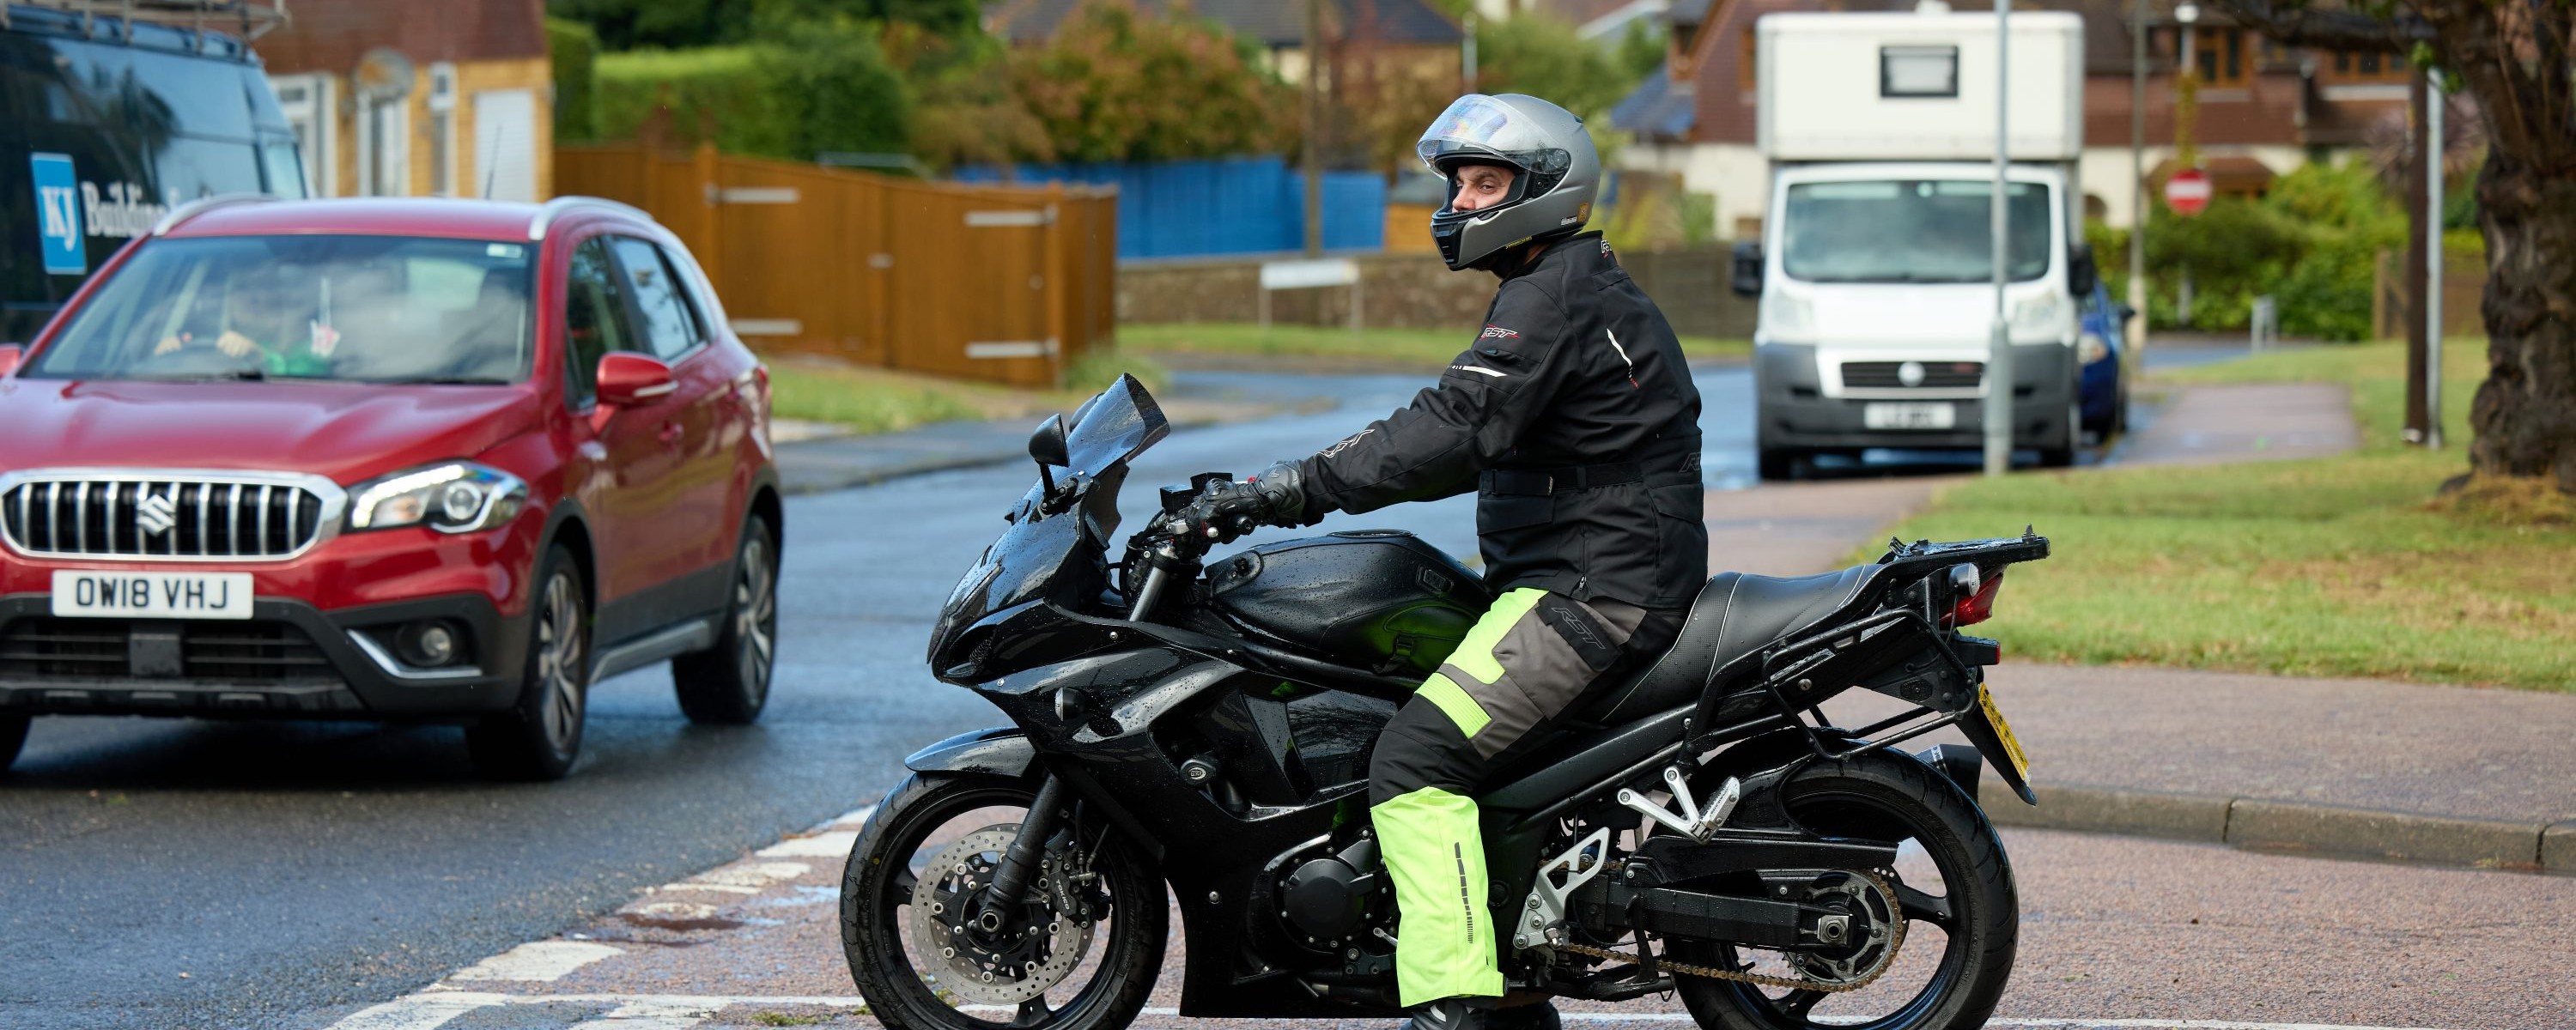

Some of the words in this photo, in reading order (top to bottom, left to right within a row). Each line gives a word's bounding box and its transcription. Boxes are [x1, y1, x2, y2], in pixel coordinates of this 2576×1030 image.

[41, 186, 76, 252] KJ
[1481, 326, 1518, 338] RST
[76, 577, 149, 608] OW18
[164, 579, 228, 609] VHJ
[1550, 607, 1607, 650] RST
[1056, 878, 1070, 910] TOKICO
